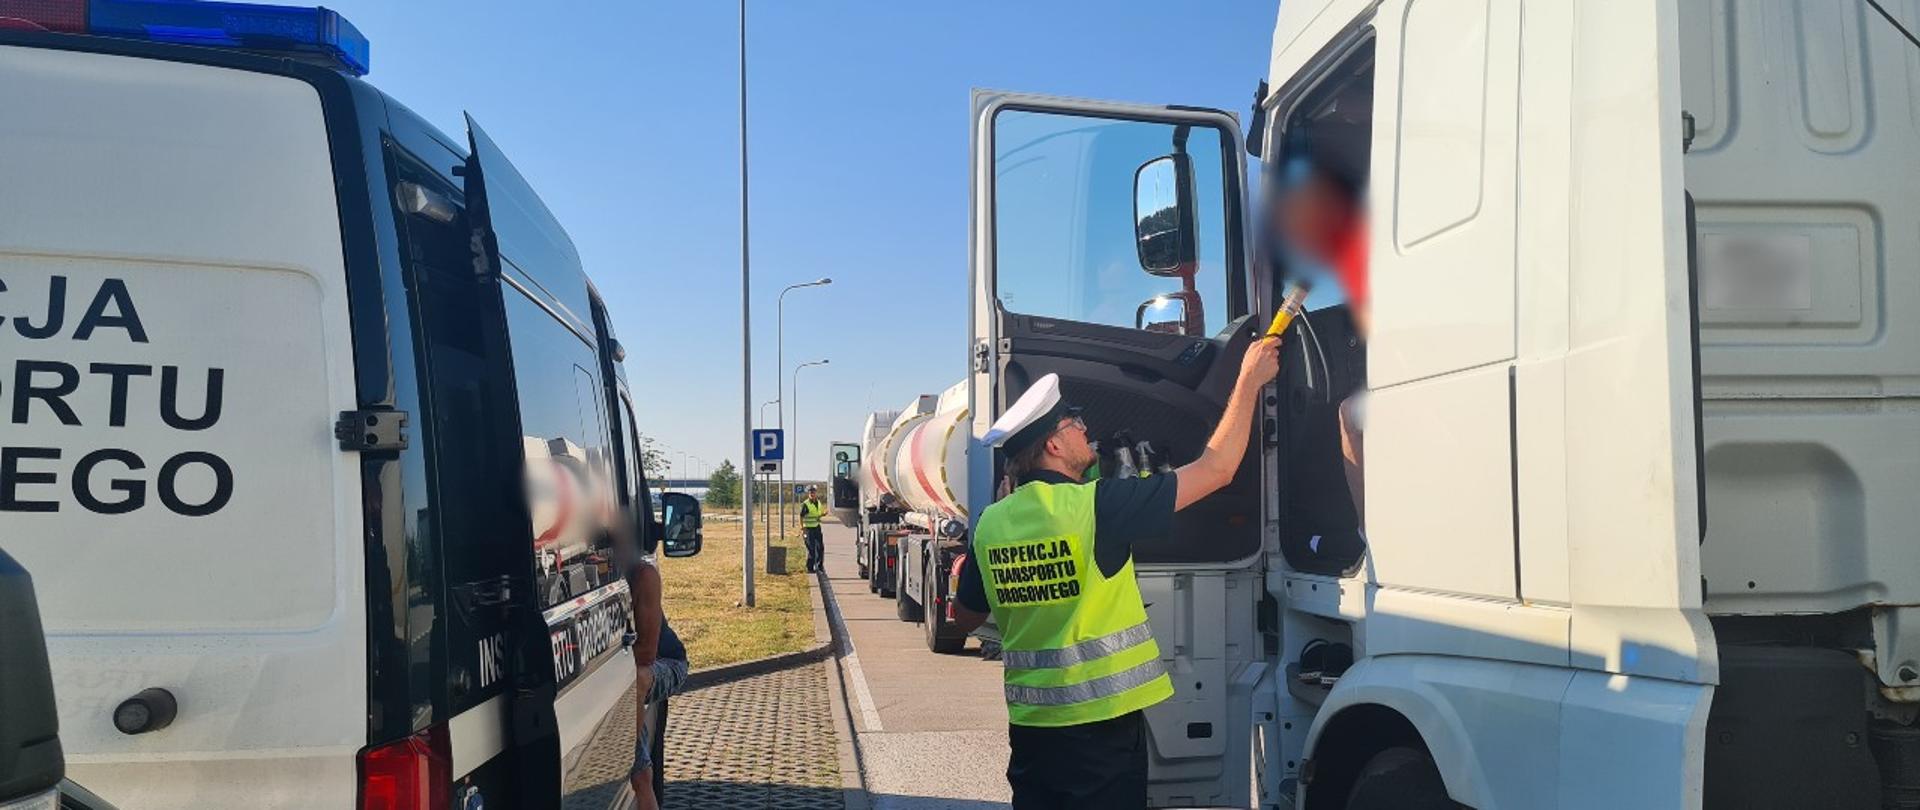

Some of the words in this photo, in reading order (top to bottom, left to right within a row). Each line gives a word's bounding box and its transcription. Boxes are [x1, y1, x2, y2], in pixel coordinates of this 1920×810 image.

[0, 275, 149, 343] JA
[0, 360, 224, 431] RTU
[760, 433, 777, 457] P
[988, 540, 1072, 565] INSPEKCJA
[991, 560, 1076, 585] TRANSPORTU
[996, 579, 1080, 604] DROGOWEGO
